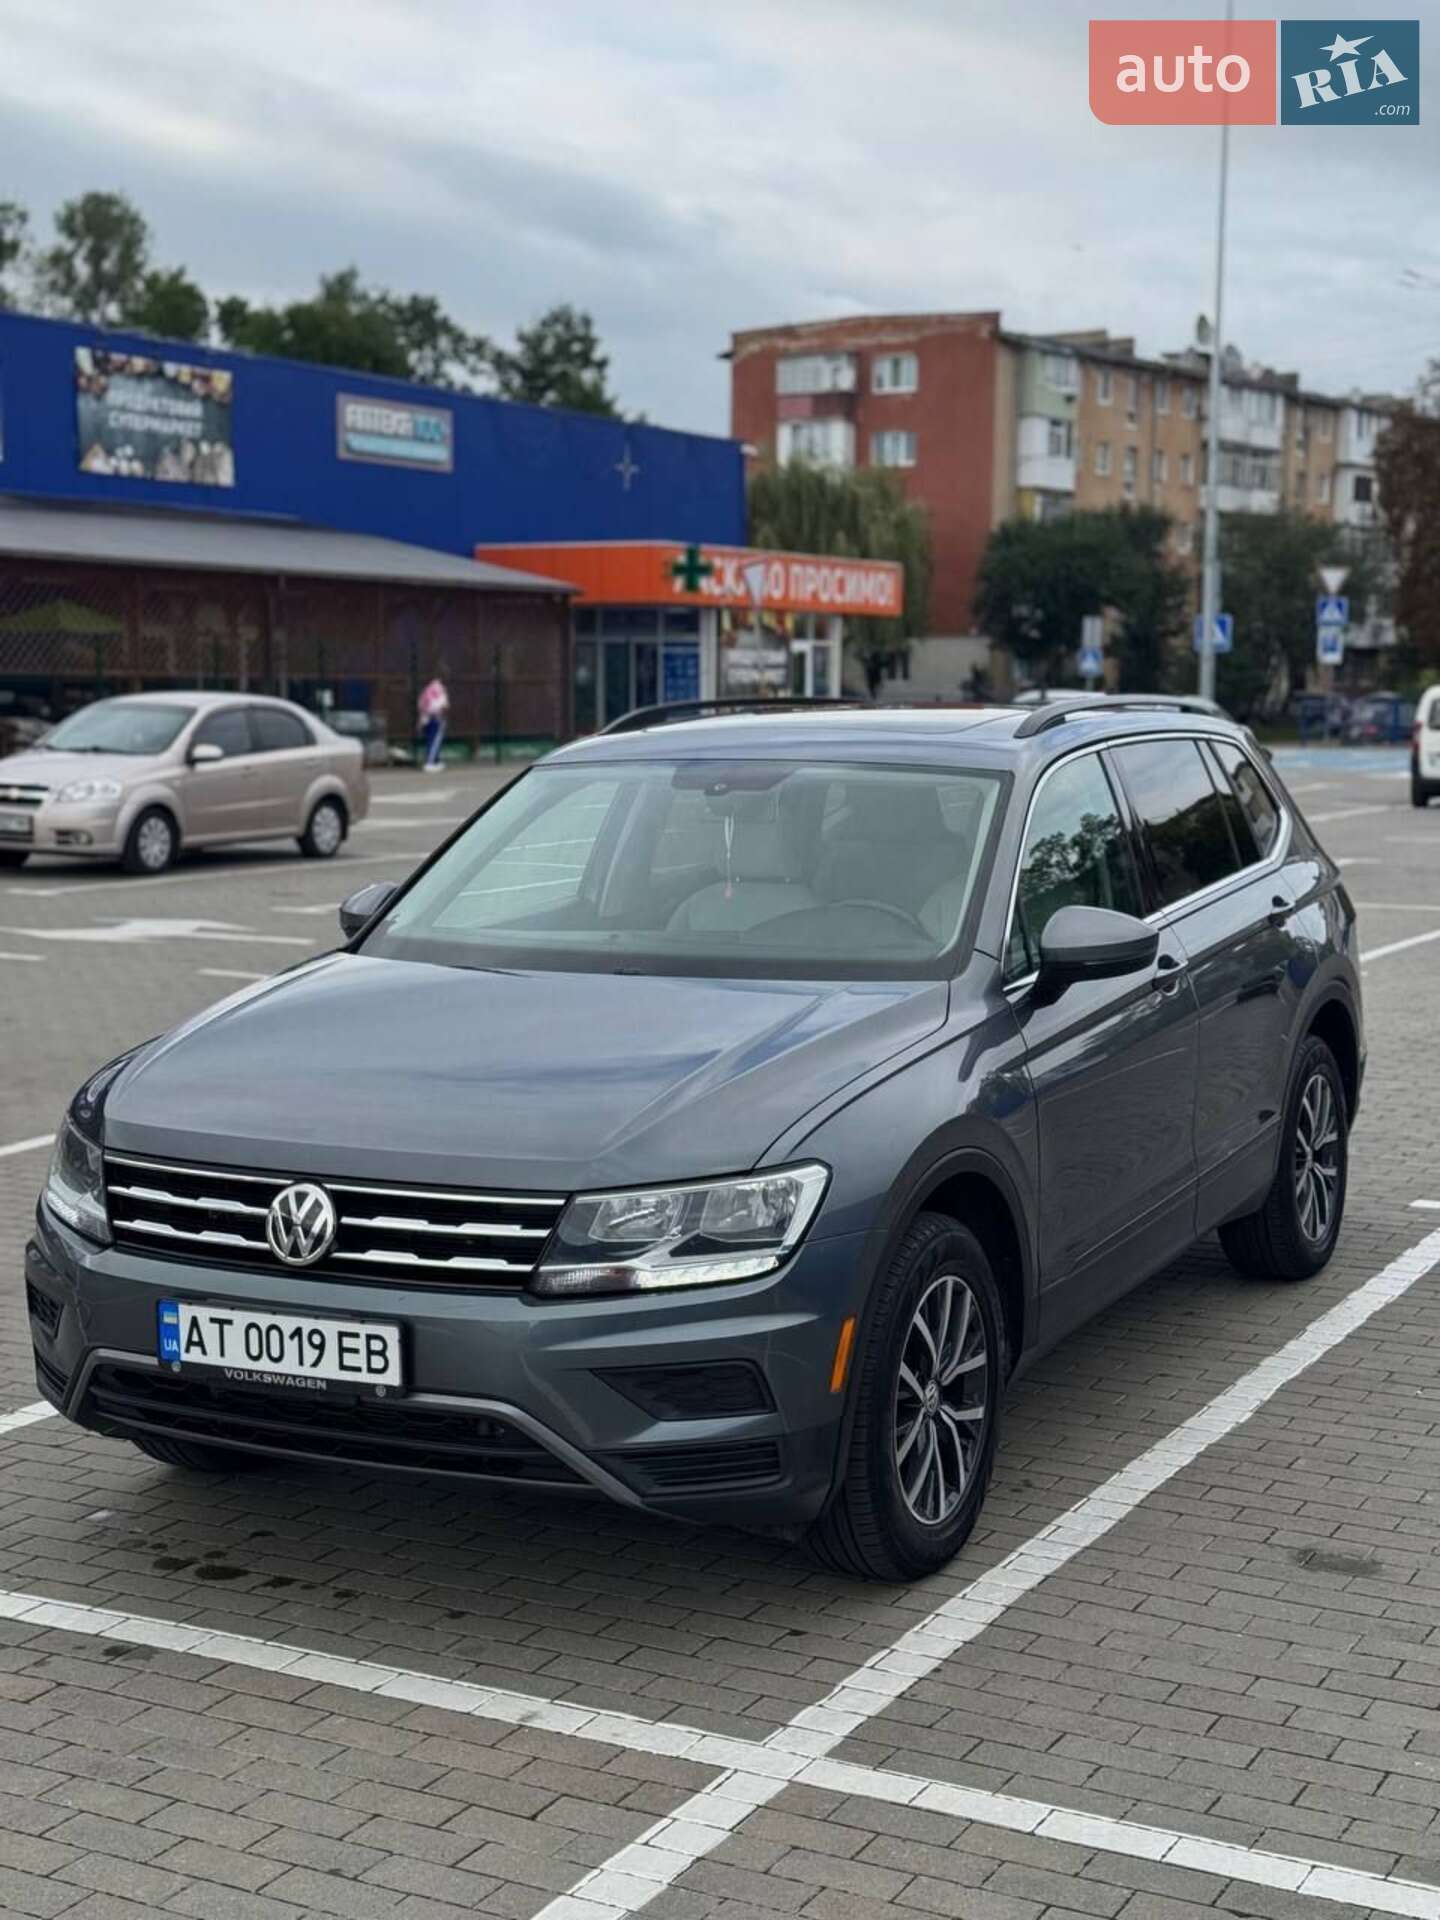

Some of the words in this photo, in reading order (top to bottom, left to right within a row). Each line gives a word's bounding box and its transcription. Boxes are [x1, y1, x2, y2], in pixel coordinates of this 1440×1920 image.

[789, 563, 896, 606] ПРОСИМО!
[163, 1337, 180, 1353] UA
[184, 1315, 234, 1358] AT
[244, 1322, 326, 1368] 0019
[337, 1330, 390, 1375] EB
[224, 1367, 328, 1390] VOLKSWAGEN
